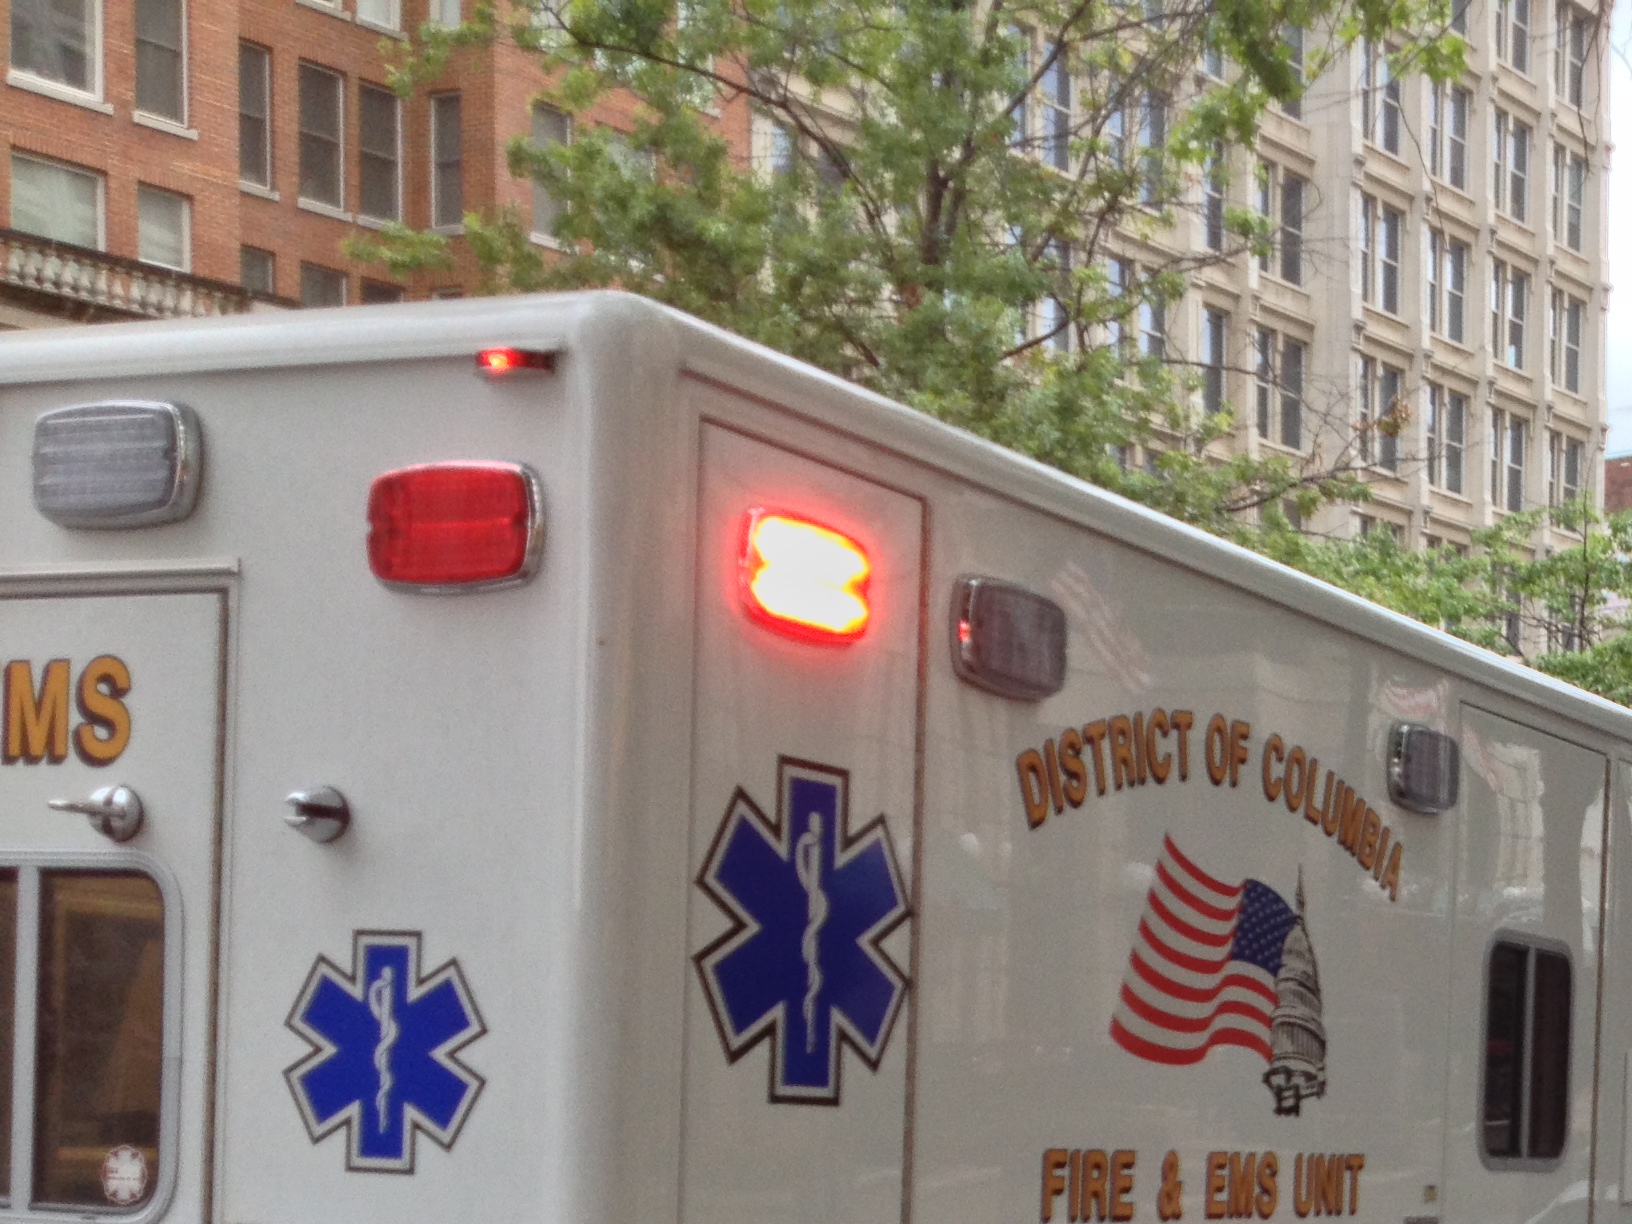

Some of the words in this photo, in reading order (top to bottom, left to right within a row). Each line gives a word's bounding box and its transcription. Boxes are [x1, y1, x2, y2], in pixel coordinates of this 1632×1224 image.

[2, 654, 132, 768] MS
[1016, 707, 1193, 830] DISTRICT
[1206, 713, 1251, 788] OF
[1262, 733, 1404, 902] COLUMBIA
[1040, 1148, 1137, 1224] FIRE
[1158, 1150, 1182, 1222] &
[1205, 1151, 1279, 1220] EMS
[1293, 1152, 1365, 1219] UNIT
